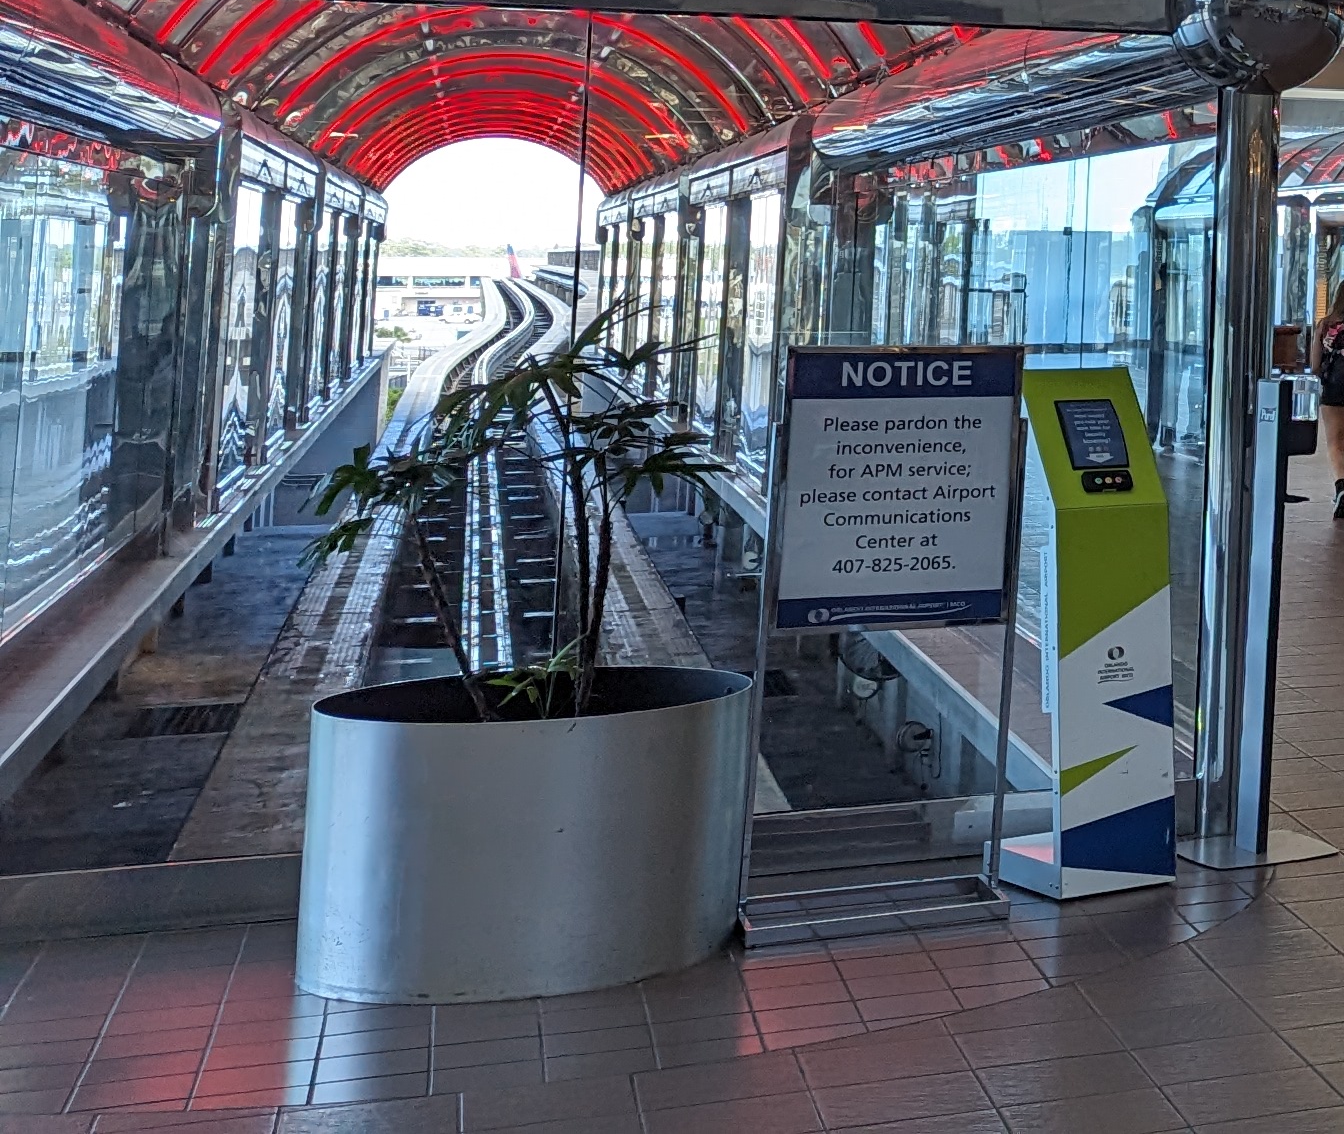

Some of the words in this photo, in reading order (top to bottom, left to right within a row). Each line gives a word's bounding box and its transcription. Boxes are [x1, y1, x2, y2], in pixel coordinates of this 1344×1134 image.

[841, 361, 973, 387] NOTICE
[823, 417, 879, 432] Please
[884, 415, 948, 434] pardon
[954, 415, 982, 429] the
[836, 439, 966, 455] inconvenience,
[828, 464, 855, 479] for
[860, 463, 903, 478] APM
[908, 461, 972, 477] service;
[800, 488, 856, 507] please
[862, 486, 928, 502] contact
[933, 484, 997, 502] Airport
[823, 509, 971, 527] Communications
[855, 535, 915, 549] Center
[920, 533, 938, 547] at
[831, 555, 956, 574] 407-825-2065.
